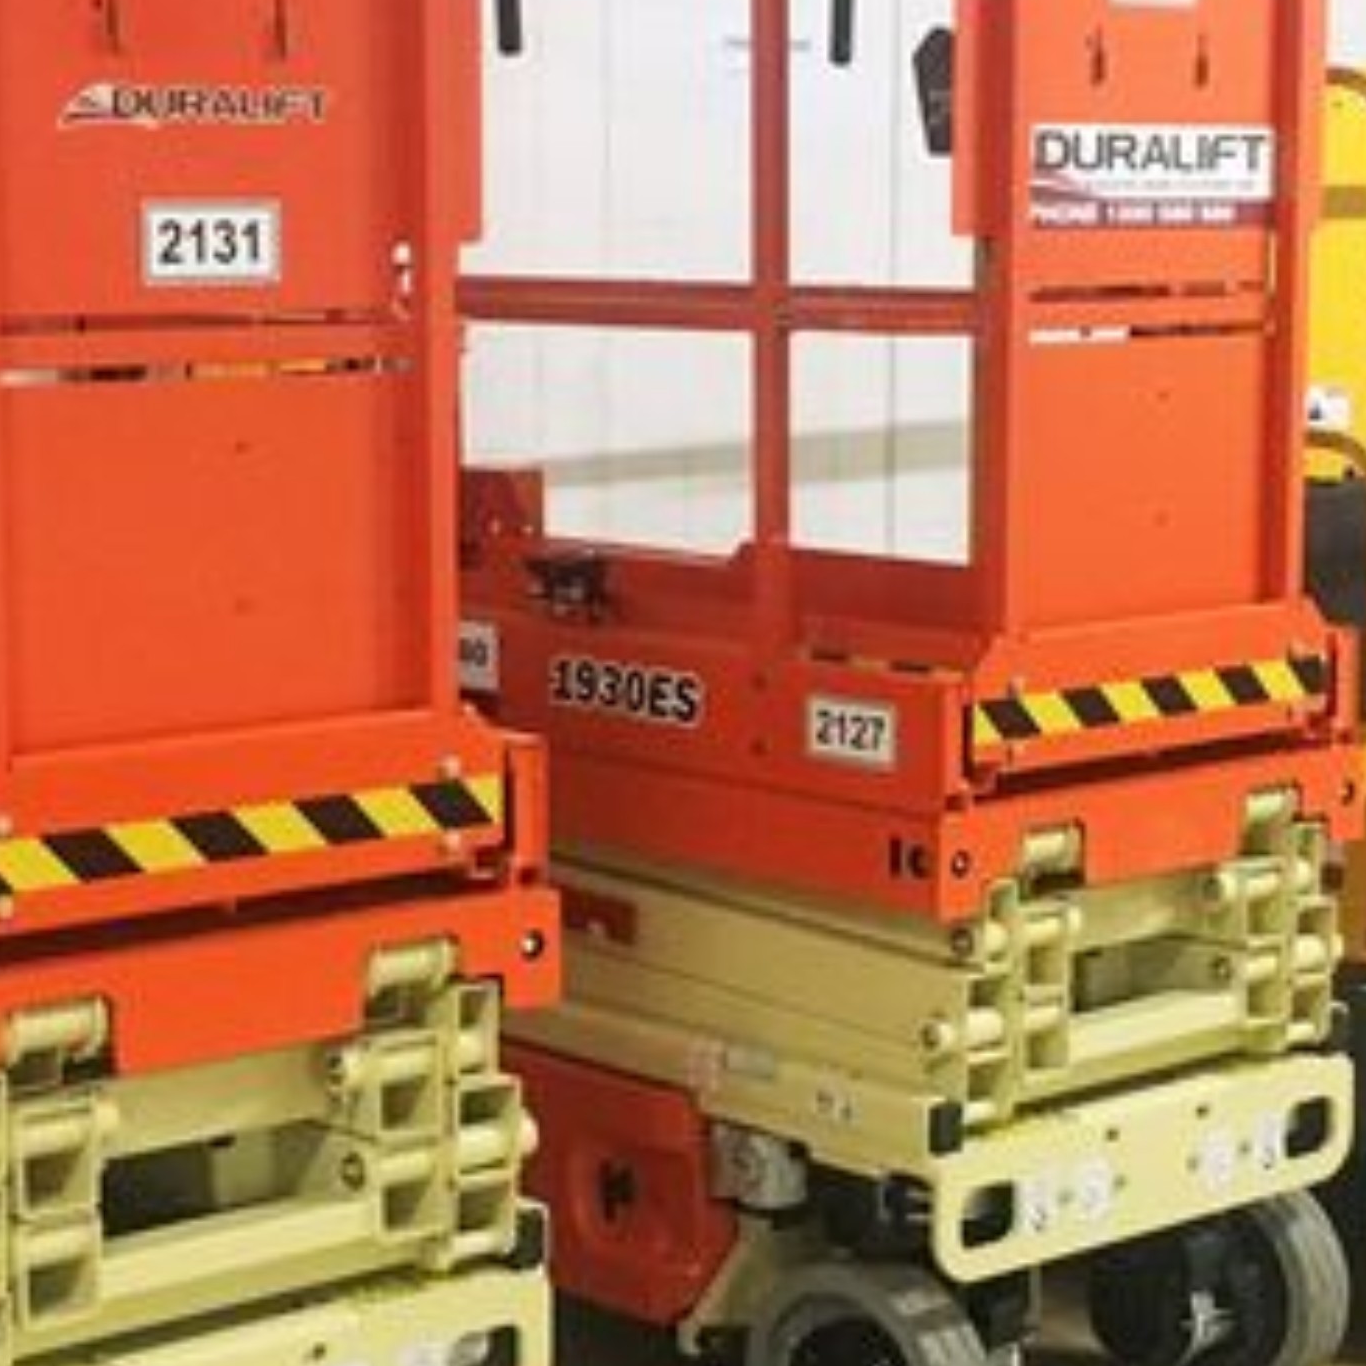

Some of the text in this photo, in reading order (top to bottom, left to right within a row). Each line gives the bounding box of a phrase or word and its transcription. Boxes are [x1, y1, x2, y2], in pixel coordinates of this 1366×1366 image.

[111, 88, 326, 120] DURALIFT
[1033, 131, 1266, 174] DURALIFT
[157, 218, 262, 265] 2131
[552, 658, 699, 723] 1930ES
[815, 709, 886, 751] 2127
